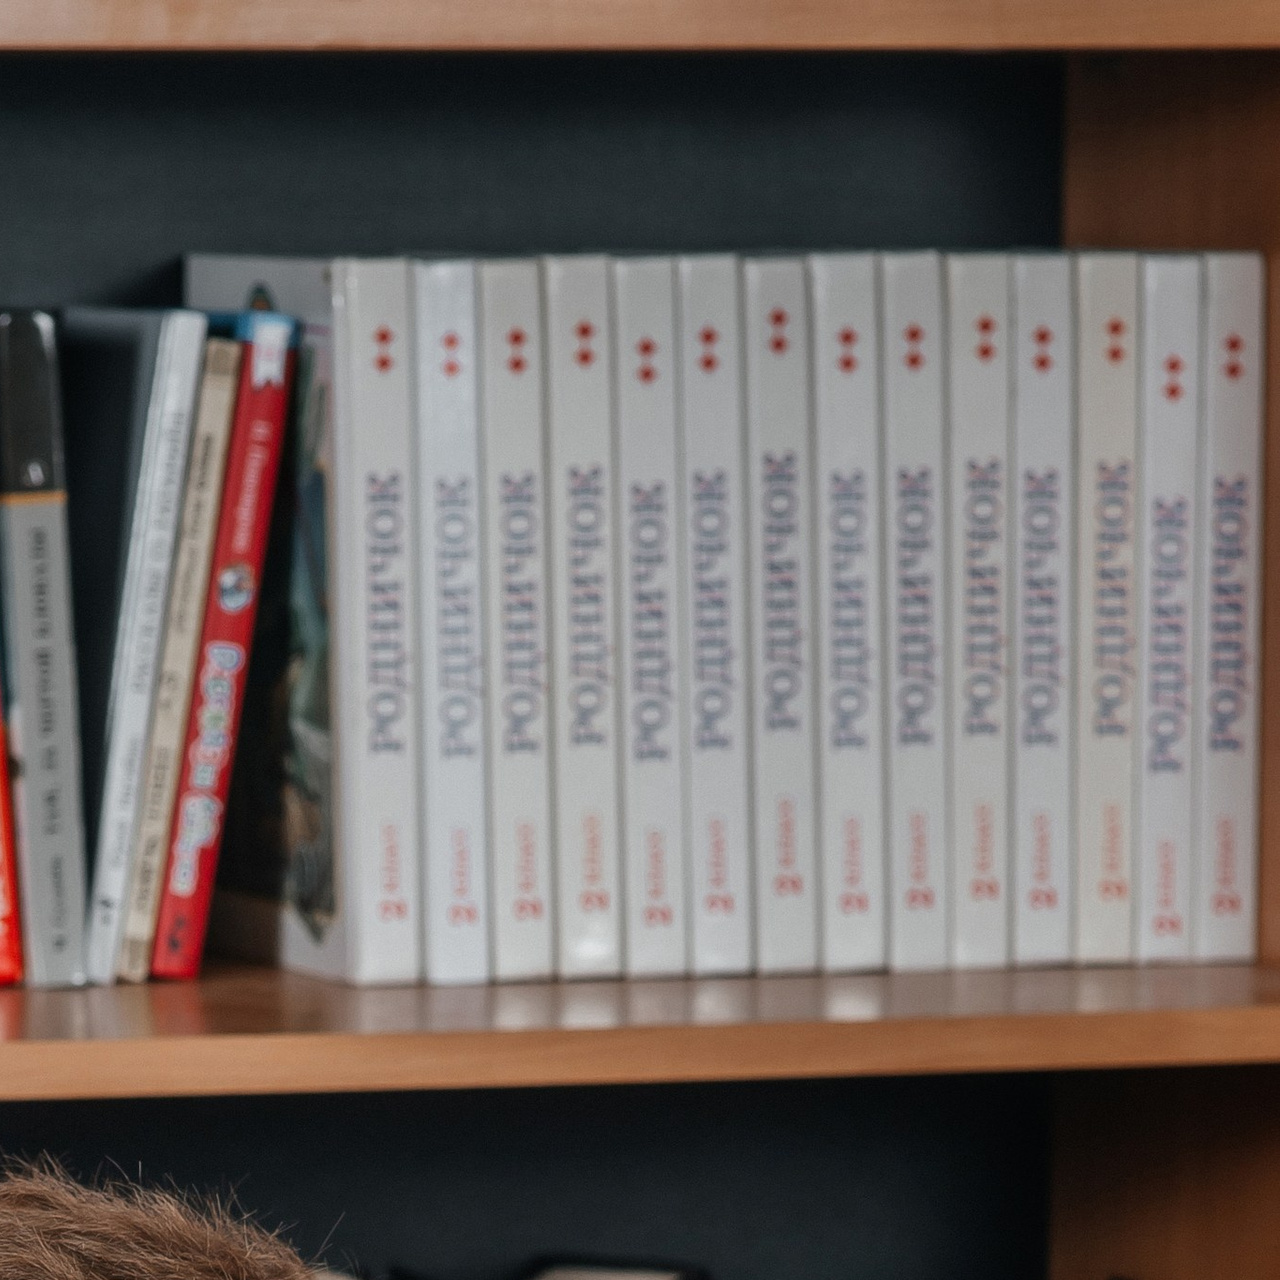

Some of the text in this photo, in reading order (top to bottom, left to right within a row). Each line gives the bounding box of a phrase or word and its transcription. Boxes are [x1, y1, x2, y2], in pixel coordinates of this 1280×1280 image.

[367, 472, 412, 754] РОДНИЧОК
[436, 478, 486, 757] РОДНИЧОК
[501, 470, 548, 753] РОДНИЧОК
[567, 466, 610, 746] РОДНИЧОК
[629, 482, 672, 761] РОДНИЧОК
[691, 471, 734, 750] РОДНИЧОК
[761, 453, 805, 732] РОДНИЧОК
[828, 470, 871, 750] РОДНИЧОК
[895, 467, 938, 746] РОДНИЧОК
[962, 458, 1006, 736] РОДНИЧОК
[1021, 469, 1064, 746] РОДНИЧОК
[1091, 461, 1136, 737] РОДНИЧОК
[1145, 498, 1188, 774] РОДНИЧОК
[1205, 476, 1250, 752] РОДНИЧОК
[379, 900, 407, 921] 2
[449, 904, 477, 926] 2
[514, 899, 542, 921] 2
[580, 889, 608, 911] 2
[644, 905, 673, 926] 2
[706, 894, 734, 913] 2
[774, 875, 802, 896] 2
[841, 893, 869, 913] 2
[906, 888, 934, 909] 2
[971, 879, 999, 900] 2
[1029, 888, 1058, 909] 2
[1099, 880, 1127, 900] 2
[1154, 916, 1183, 936] 2
[1213, 894, 1242, 913] 2
